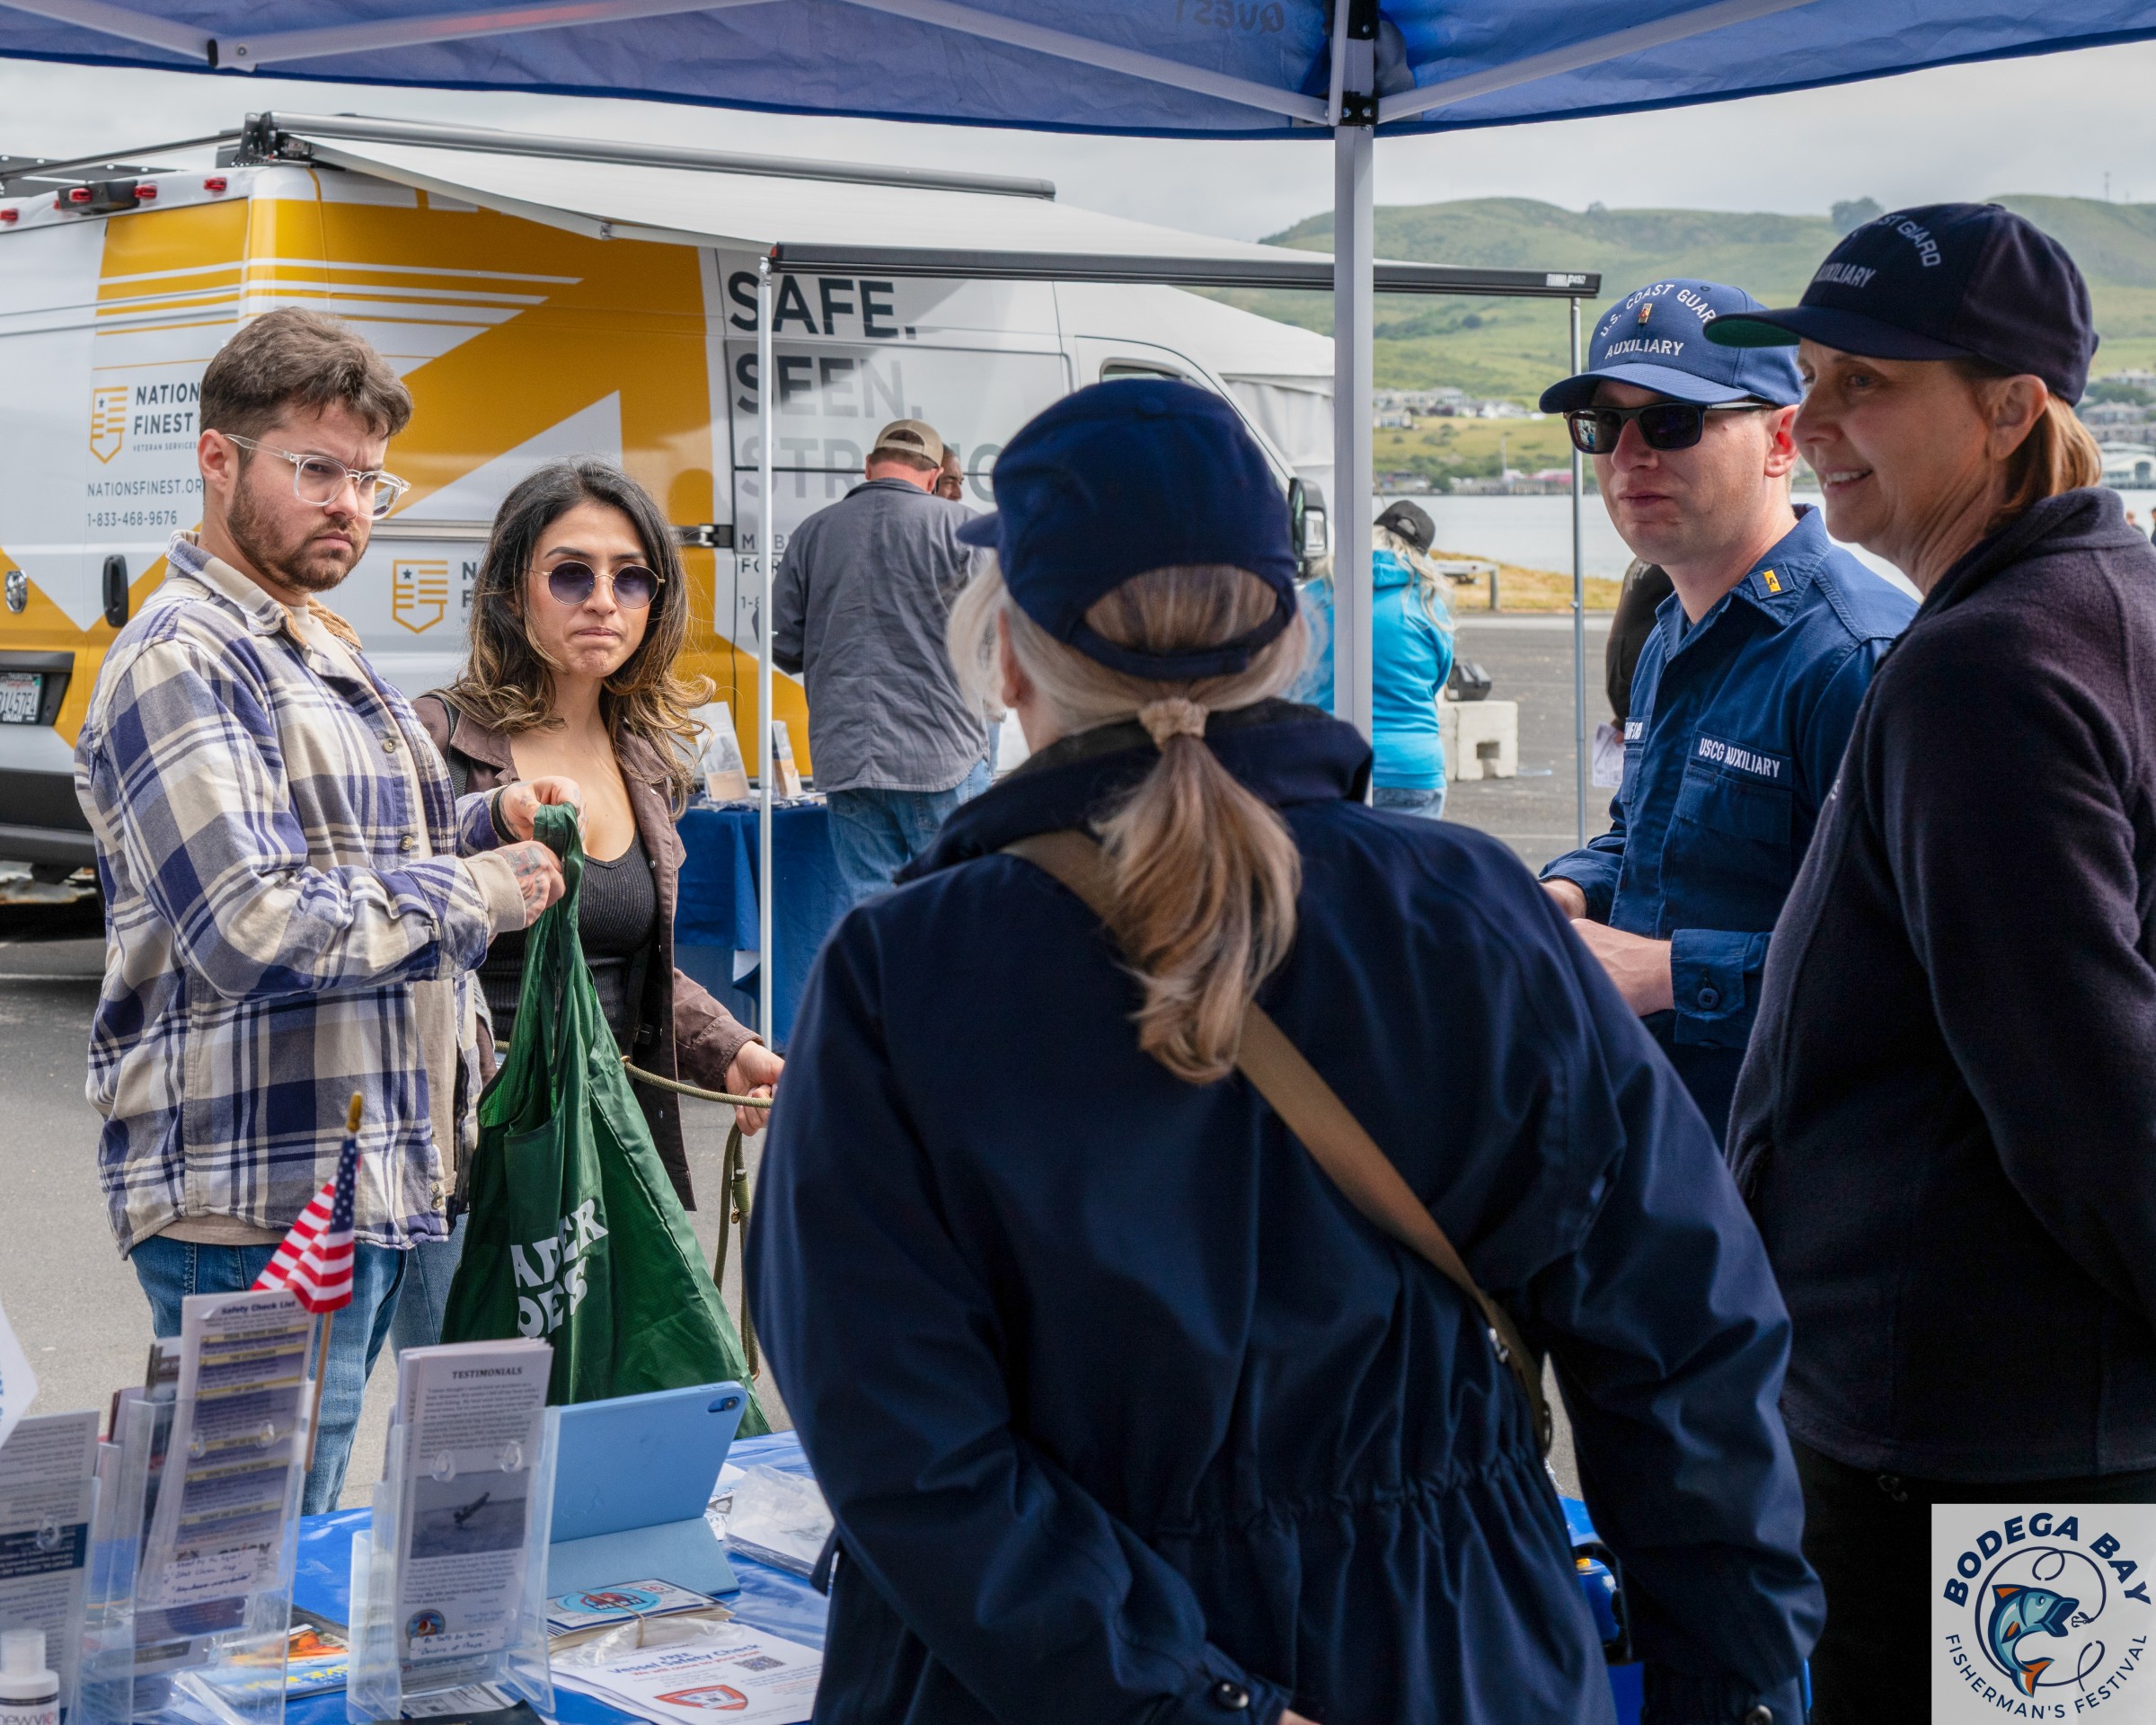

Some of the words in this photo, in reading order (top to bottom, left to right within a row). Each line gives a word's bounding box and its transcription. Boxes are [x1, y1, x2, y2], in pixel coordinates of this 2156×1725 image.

[727, 271, 917, 340] SAFE.
[1600, 314, 1621, 337] U.S.
[1626, 284, 1674, 309] COAST
[1676, 289, 1717, 323] GUAR
[1604, 339, 1683, 359] AUXILIARY
[136, 382, 201, 405] NATION
[736, 353, 923, 420] SEEN.
[134, 412, 193, 435] FINEST
[133, 444, 163, 452] VETERAN
[165, 441, 197, 450] SERVICES
[87, 479, 202, 497] NATIONSFINEST.OR
[87, 510, 177, 527] 1-833-468-9676
[1698, 738, 1725, 762] USCG
[1724, 746, 1780, 778] AUXILIARY
[453, 1367, 522, 1379] TESTIMONIALS
[608, 1662, 661, 1674] Vessel
[661, 1654, 712, 1668] Safety
[713, 1644, 760, 1657] Check
